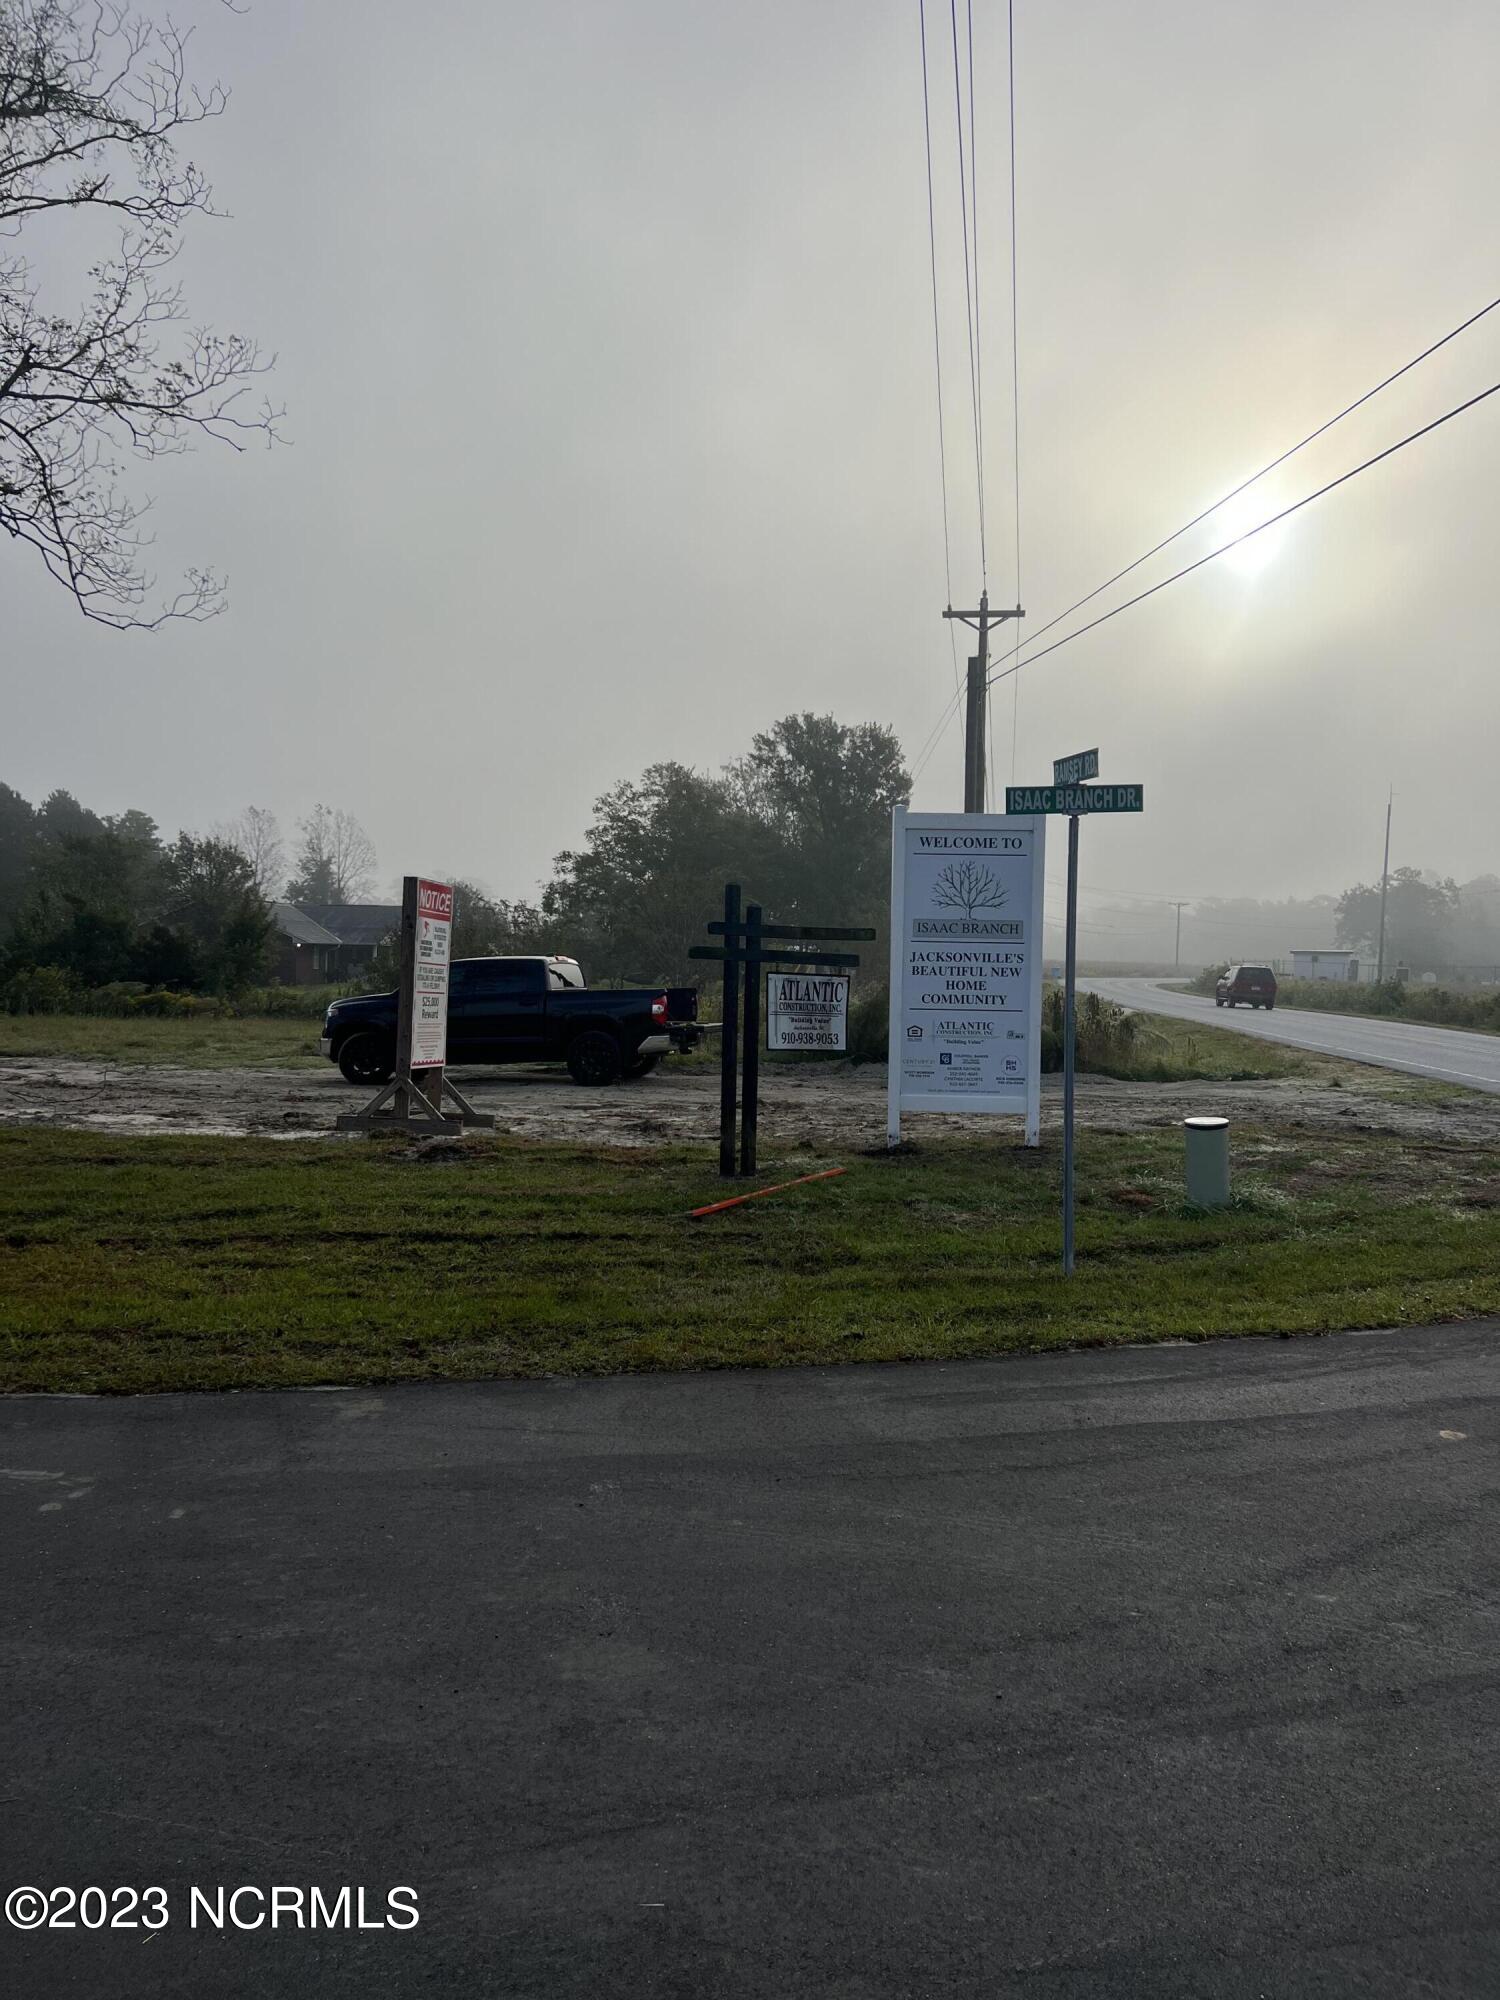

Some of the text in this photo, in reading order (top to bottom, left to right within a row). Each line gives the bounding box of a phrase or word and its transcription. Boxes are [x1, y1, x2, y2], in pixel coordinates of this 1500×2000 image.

[1054, 758, 1083, 784] RAMSEY
[1009, 787, 1140, 811] ISAAC BRANCH DR.
[920, 836, 1022, 849] WELCOME TO
[420, 887, 451, 912] NOTICE
[917, 922, 1019, 935] ISAAC BRANCH
[910, 951, 1024, 964] JACKSONVILLE'S
[911, 965, 1022, 977] BEAUTIFUL NEW
[779, 980, 843, 1003] ATLANTIC
[945, 980, 987, 991] HOME
[921, 993, 1008, 1005] COMMUNITY
[422, 1009, 439, 1019] Reward
[779, 1002, 828, 1013] CONSTRUCTION,
[937, 1021, 994, 1031] ATLANTIC
[781, 1031, 839, 1045] 910-938-9053
